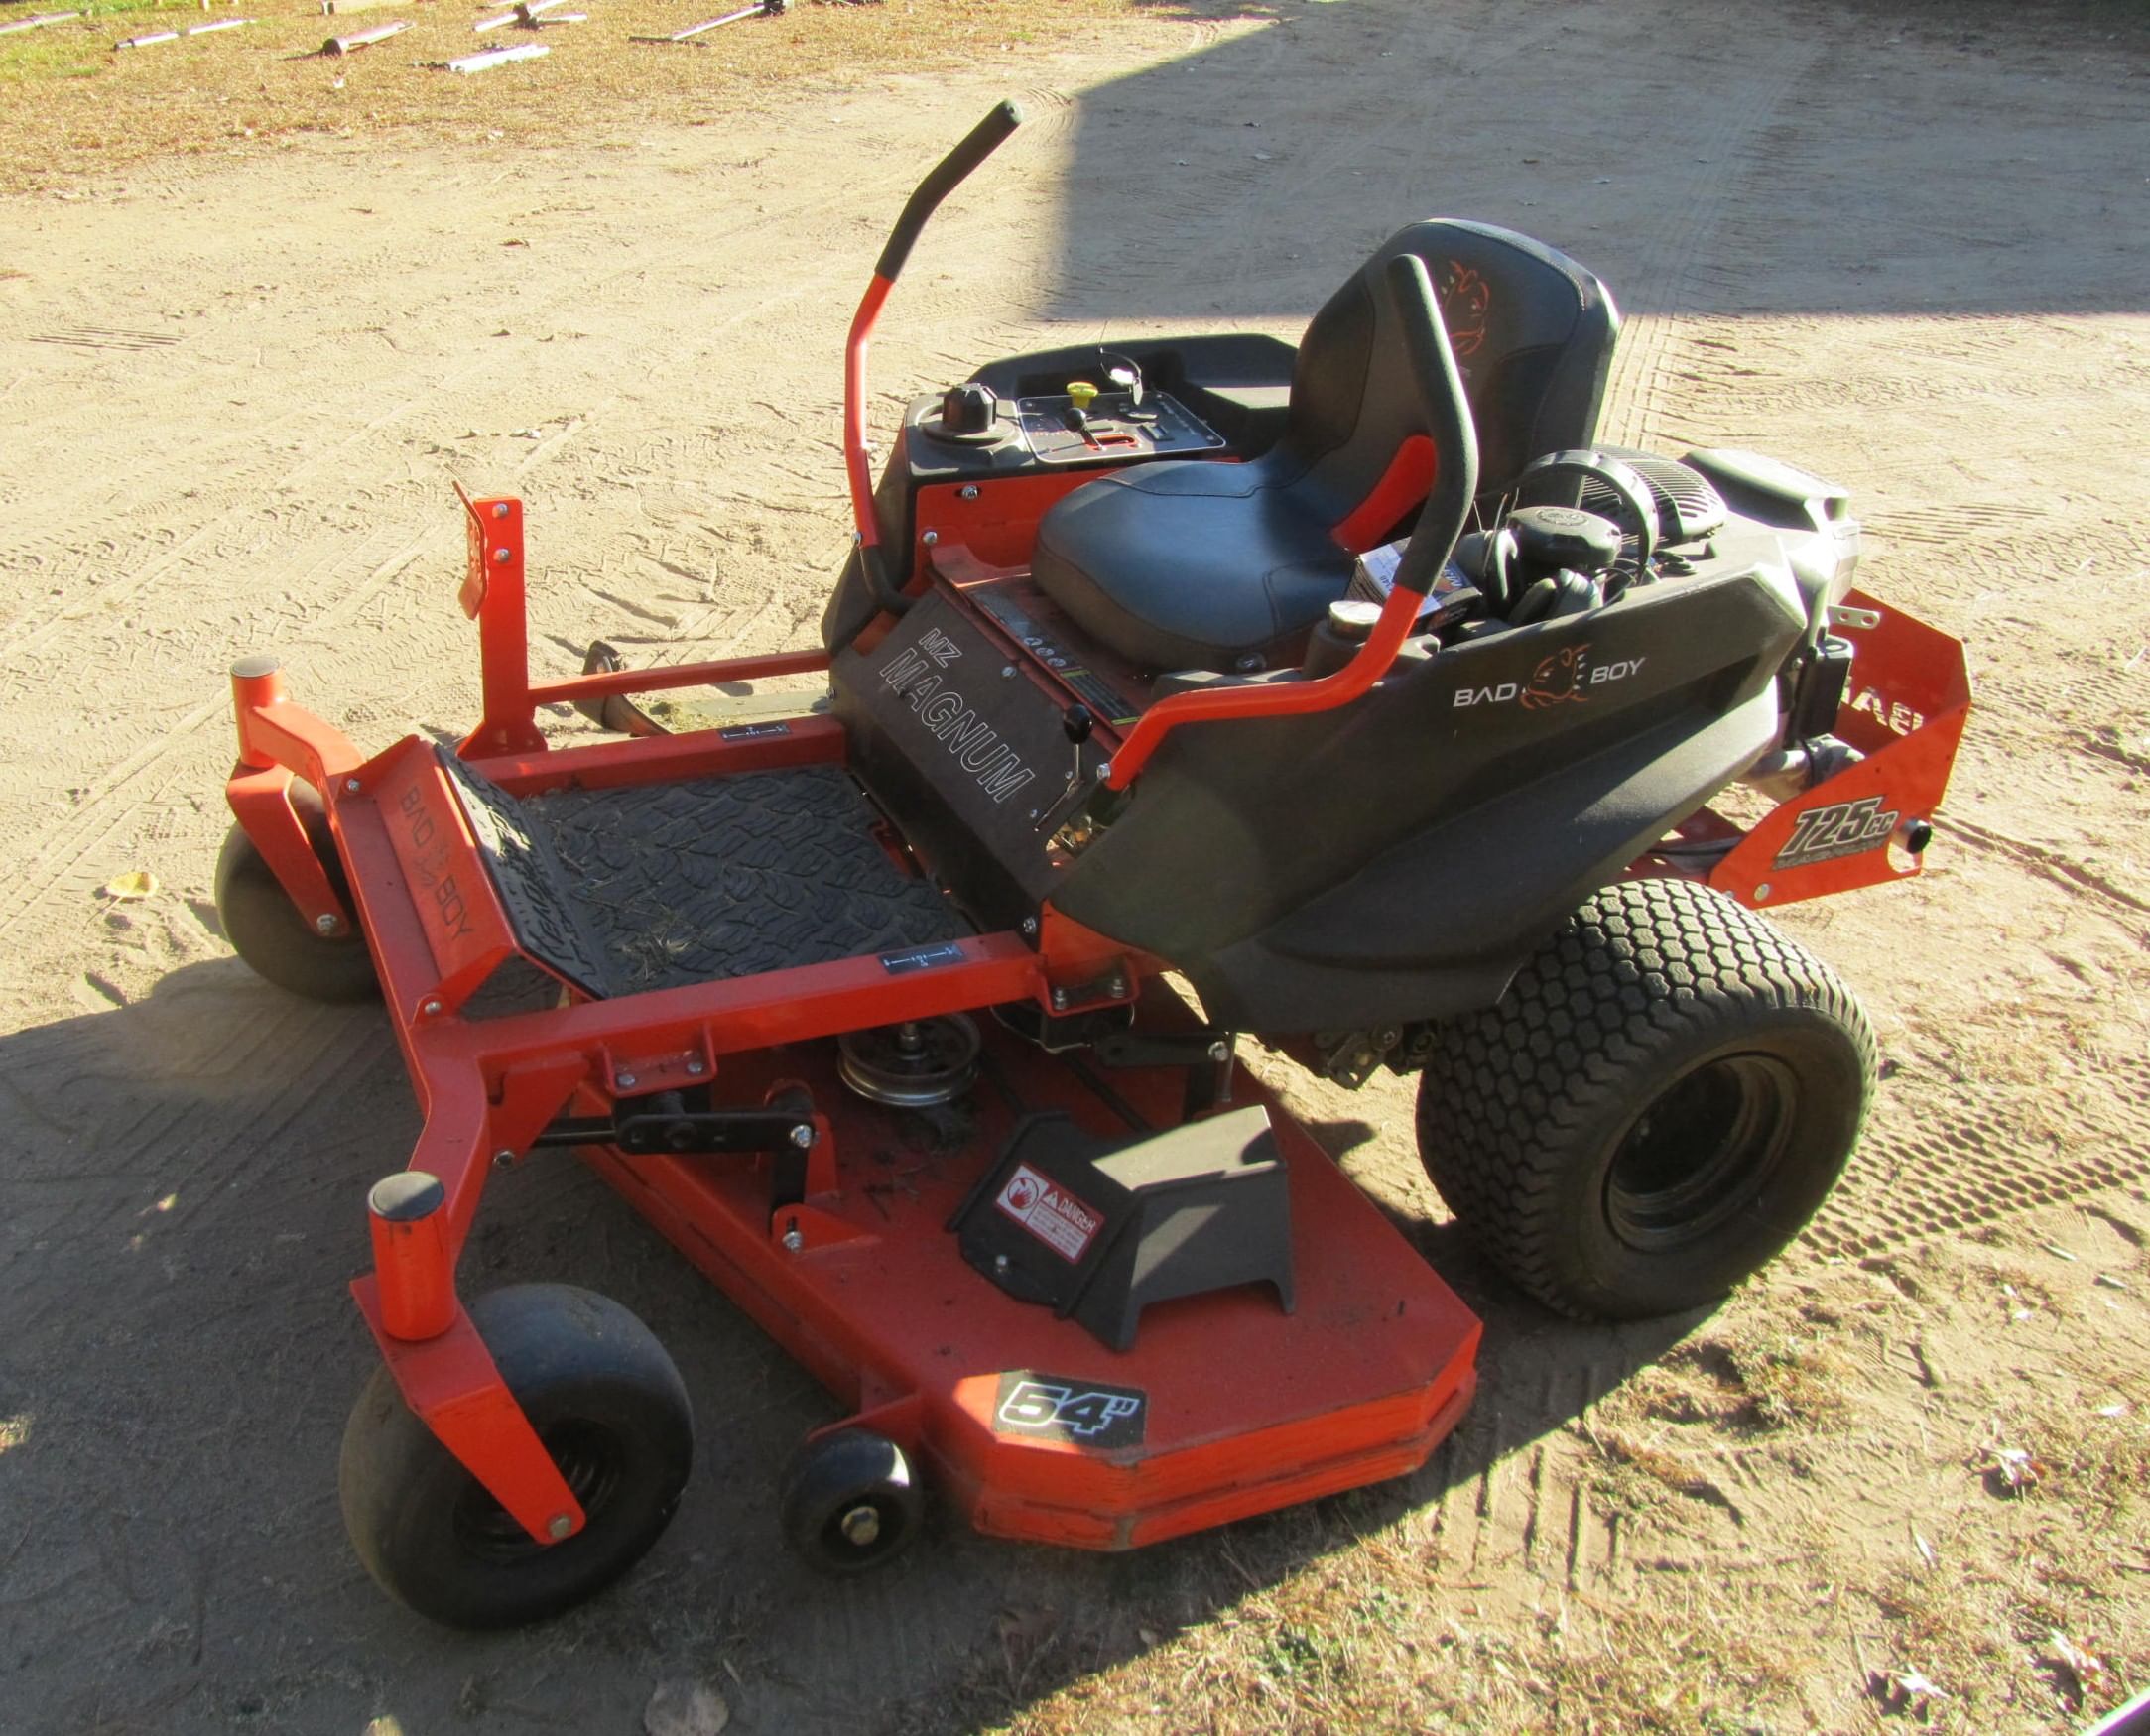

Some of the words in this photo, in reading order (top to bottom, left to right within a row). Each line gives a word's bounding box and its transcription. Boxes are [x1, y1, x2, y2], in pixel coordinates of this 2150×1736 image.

[918, 627, 963, 669] MZ
[1453, 682, 1517, 708] BAD
[1590, 656, 1647, 685] BOY
[879, 647, 1036, 804] MAGNUM
[399, 785, 435, 848] BAD
[435, 876, 473, 941] BOY
[1056, 1197, 1097, 1232] DANGER
